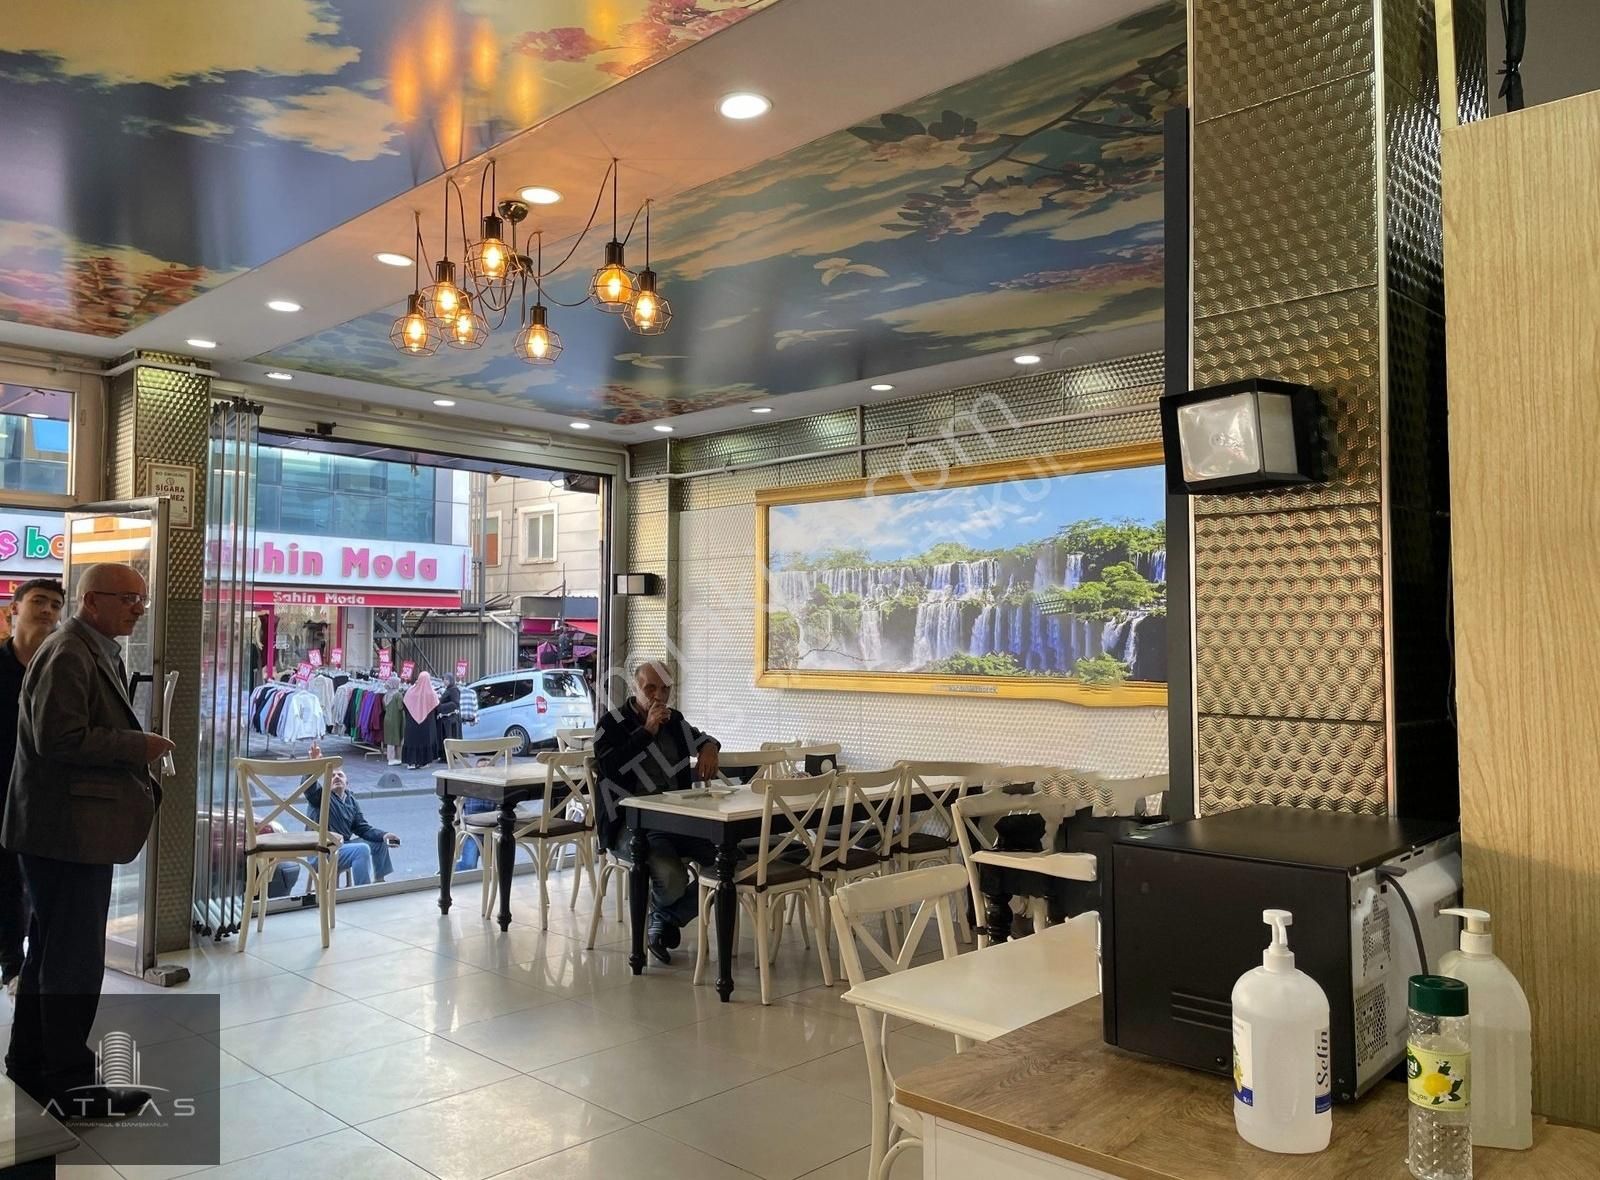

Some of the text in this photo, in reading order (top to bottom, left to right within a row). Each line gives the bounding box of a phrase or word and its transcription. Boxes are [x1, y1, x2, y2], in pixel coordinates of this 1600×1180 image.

[341, 546, 438, 580] Moda
[325, 593, 366, 605] Moda
[1316, 1031, 1329, 1086] Selin
